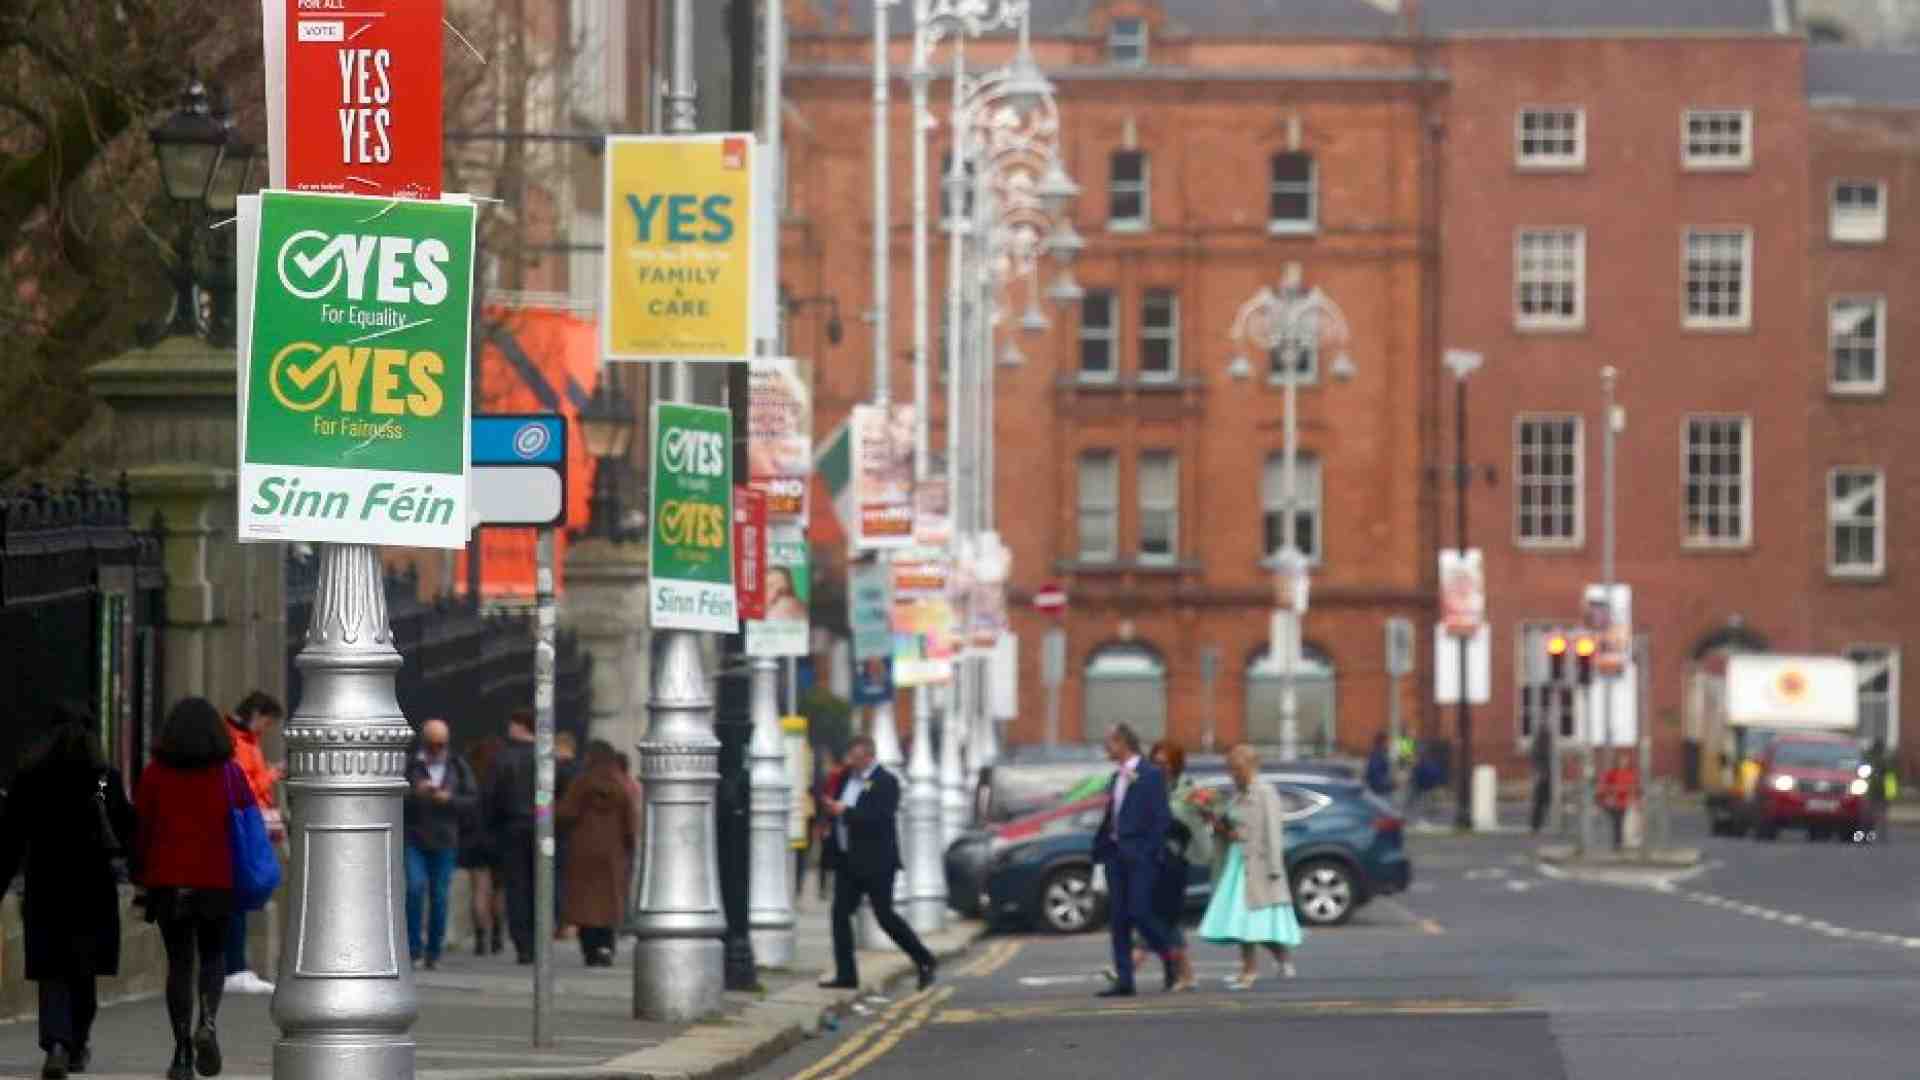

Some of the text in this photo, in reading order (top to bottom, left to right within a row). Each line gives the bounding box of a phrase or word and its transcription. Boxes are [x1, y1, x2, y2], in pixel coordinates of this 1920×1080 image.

[303, 26, 336, 36] VOTE
[338, 49, 390, 104] YES
[339, 109, 391, 164] YES
[626, 194, 734, 243] YES
[337, 234, 450, 305] YES
[639, 267, 720, 284] FAMILY
[322, 304, 406, 330] For Equality
[648, 299, 710, 317] CARE
[330, 345, 445, 417] YES
[313, 416, 402, 440] For Fairness
[682, 430, 724, 477] YES
[251, 477, 456, 526] Sinn Féin
[680, 503, 724, 548] YES
[656, 586, 695, 613] Sinn
